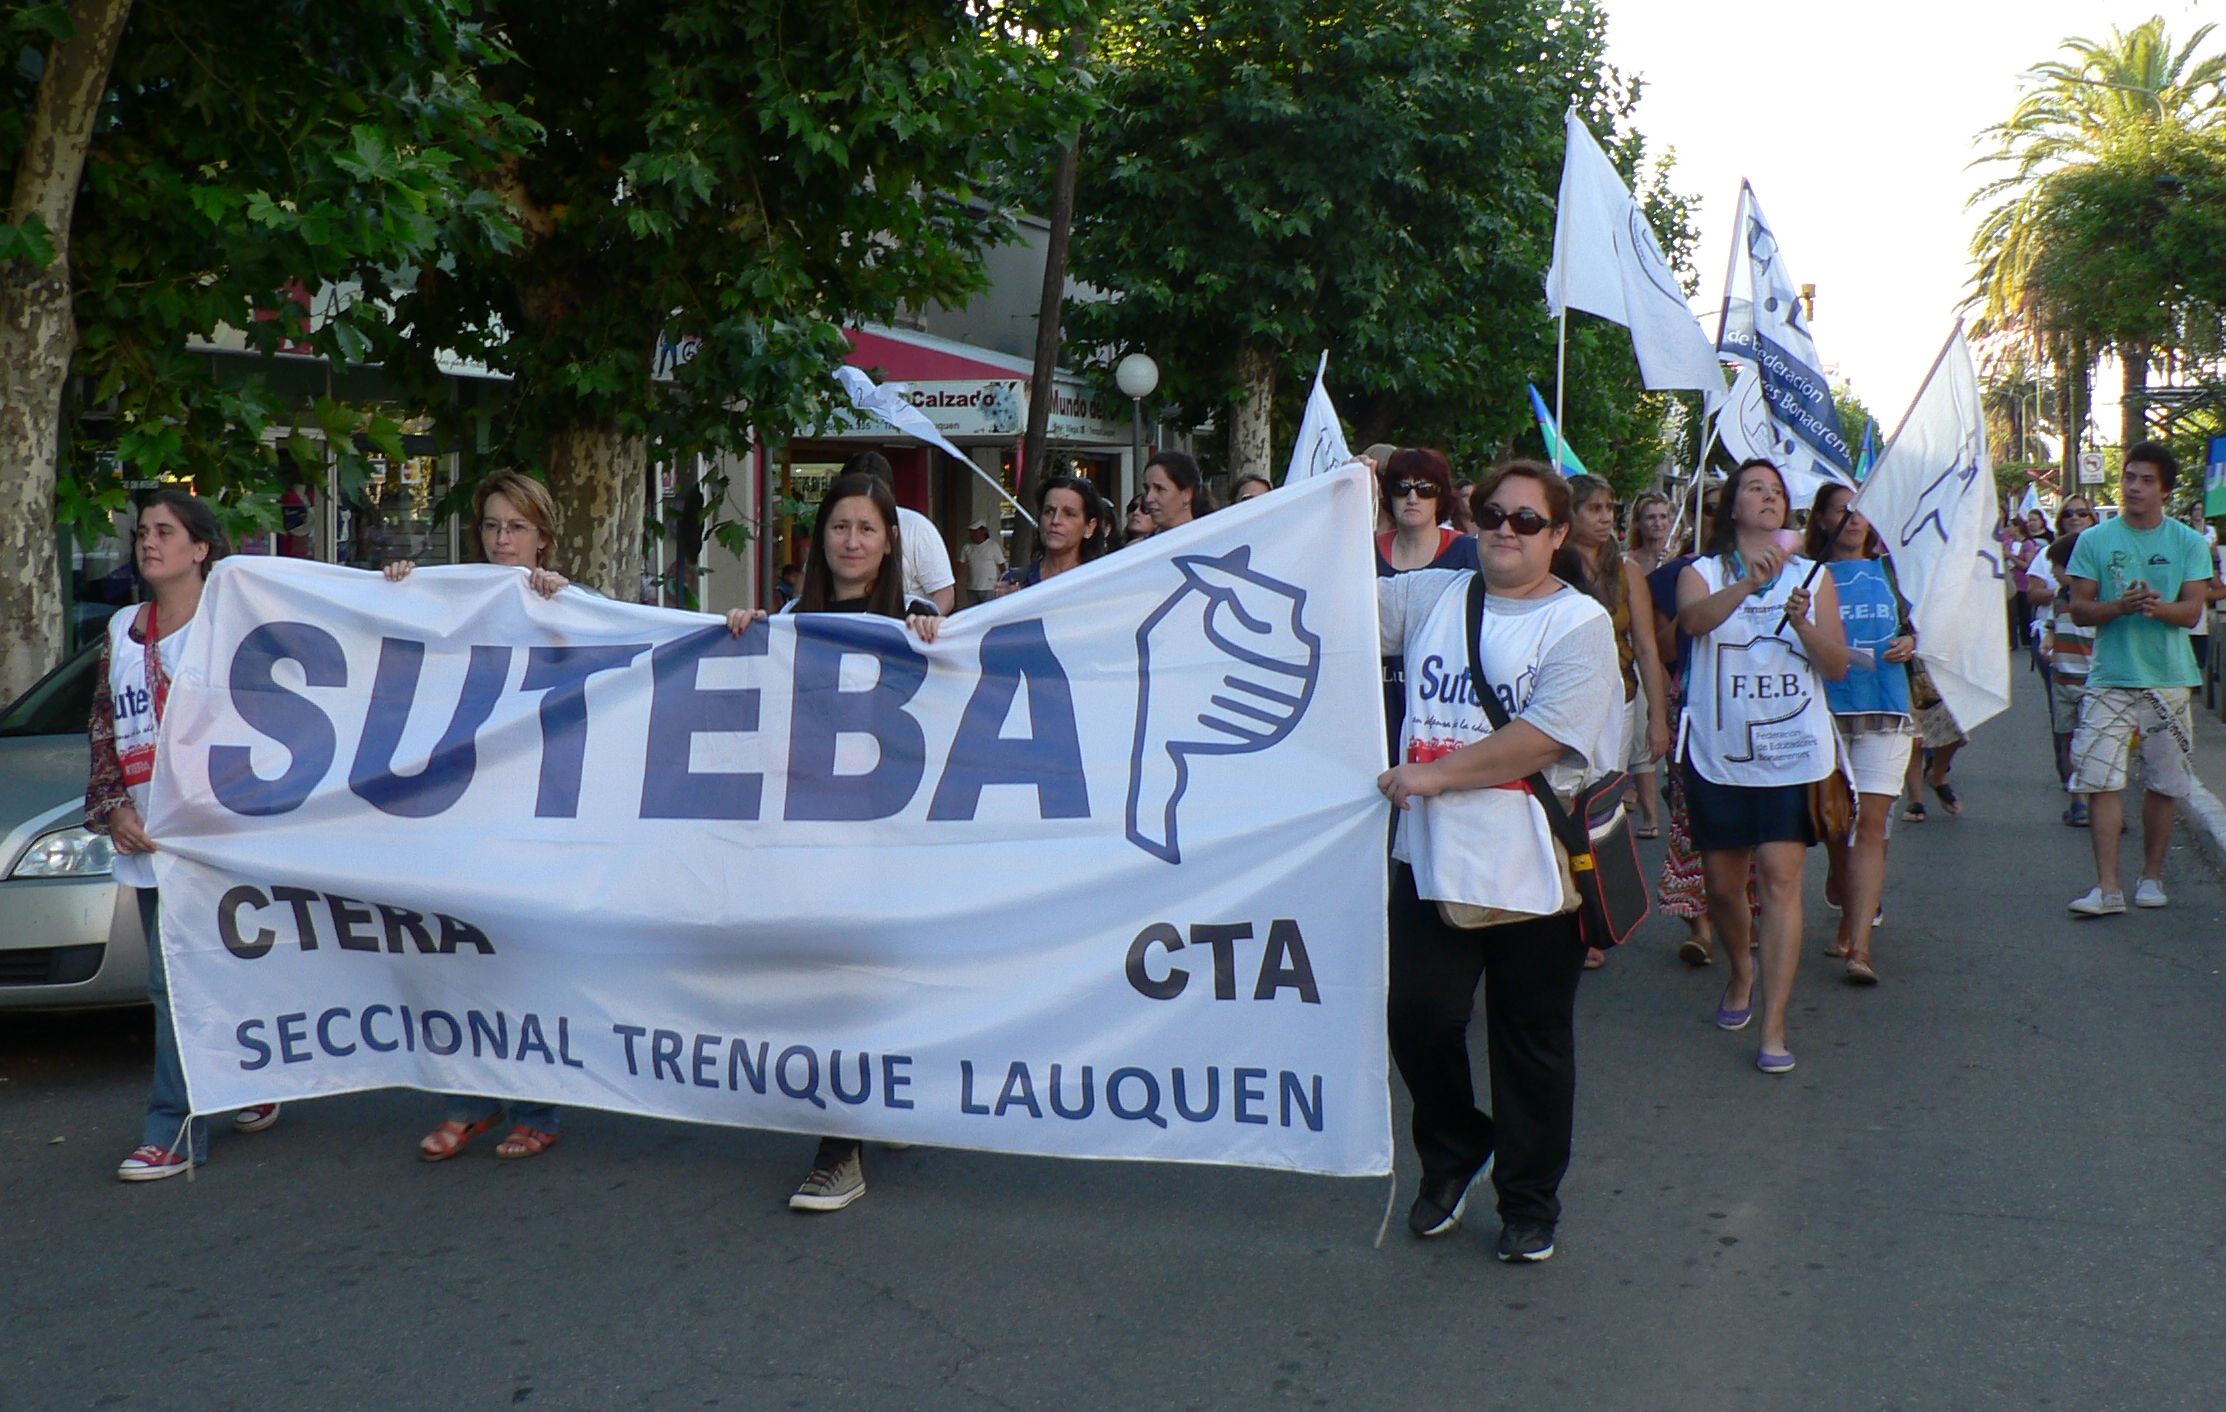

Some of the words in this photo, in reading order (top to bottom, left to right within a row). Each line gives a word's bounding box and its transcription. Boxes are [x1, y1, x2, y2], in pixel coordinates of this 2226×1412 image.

[1757, 342, 1824, 404] ederación
[1839, 603, 1895, 621] F.E.B.
[208, 613, 1091, 822] SUTEBA
[1730, 673, 1807, 699] F.E.B.
[217, 885, 497, 960] CTERA
[1125, 919, 1322, 1005] CTA
[235, 1004, 584, 1071] SECCIONAL
[612, 1023, 915, 1110] TRENQUE
[960, 1060, 1323, 1132] LAUQUEN
